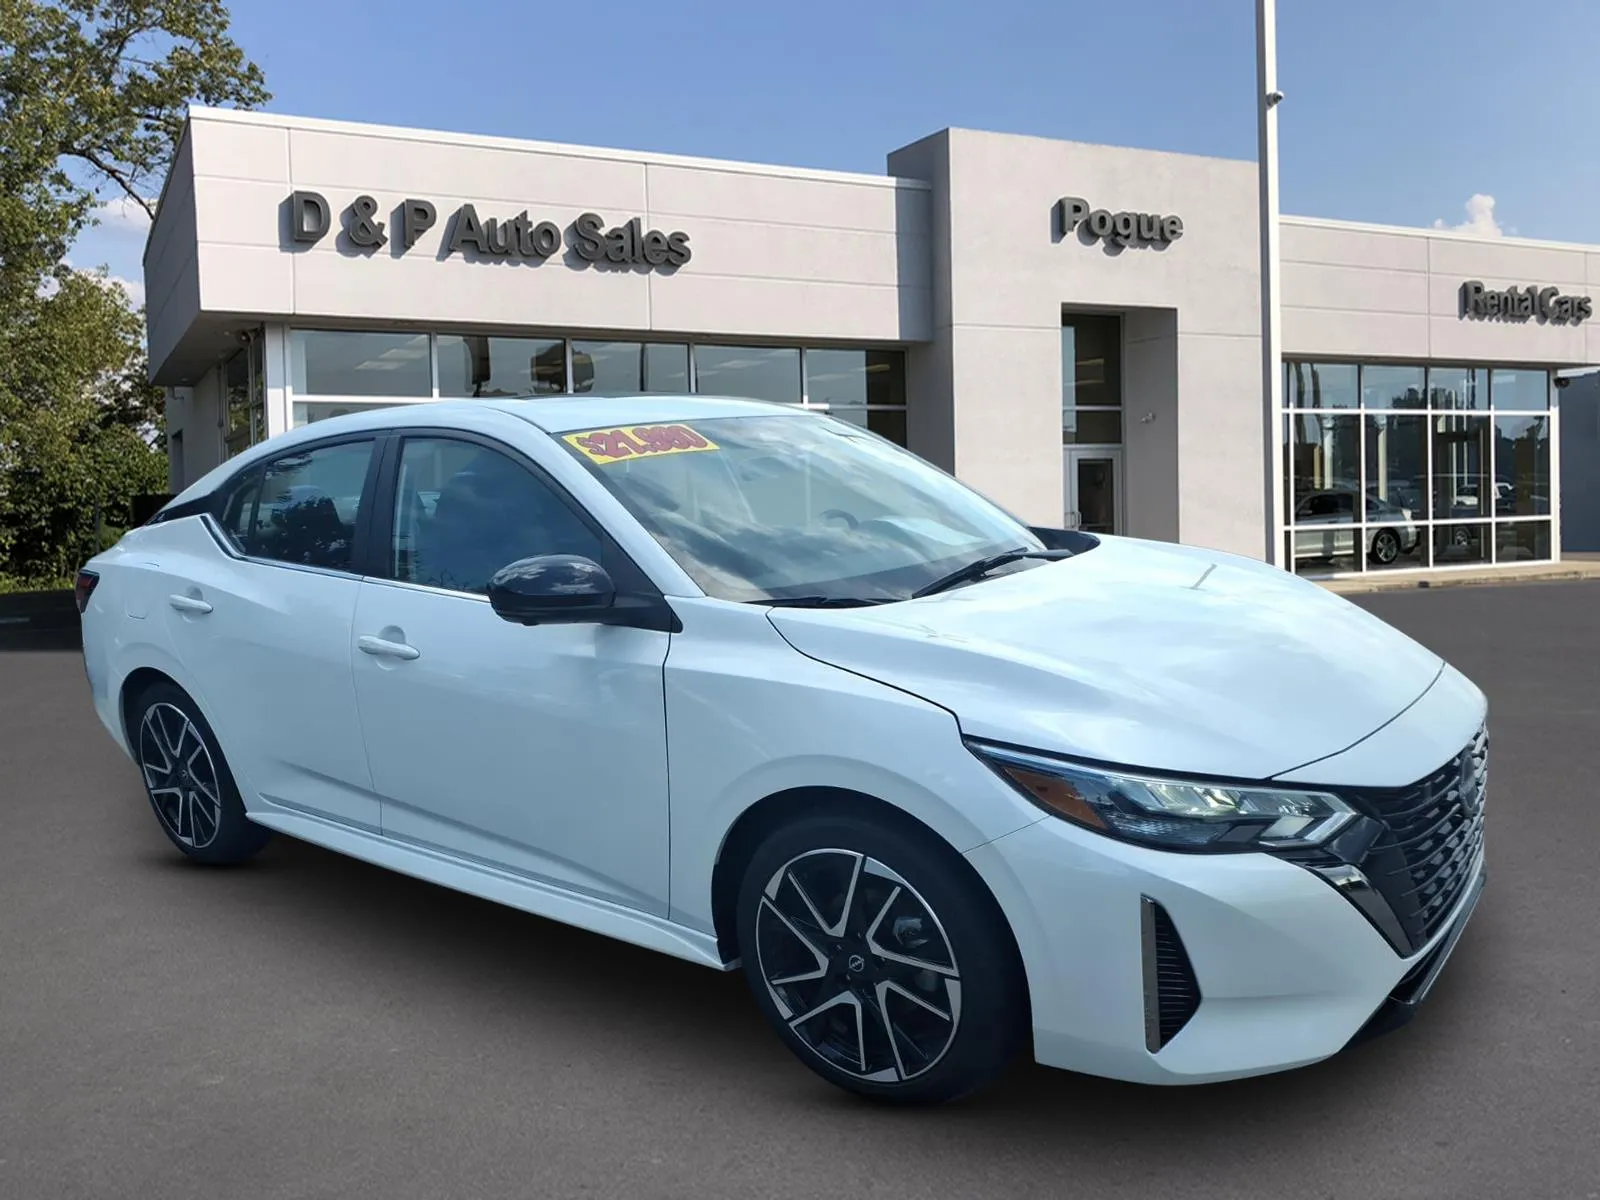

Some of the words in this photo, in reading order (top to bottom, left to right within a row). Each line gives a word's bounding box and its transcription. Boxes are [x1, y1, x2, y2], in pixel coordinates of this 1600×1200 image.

[288, 190, 331, 243] D
[342, 195, 388, 250] &
[400, 199, 437, 250] P
[447, 204, 561, 259] Auto
[567, 212, 692, 268] Sales
[1055, 197, 1184, 250] Pogue
[1460, 280, 1538, 320] Rental
[1539, 286, 1592, 324] Cars
